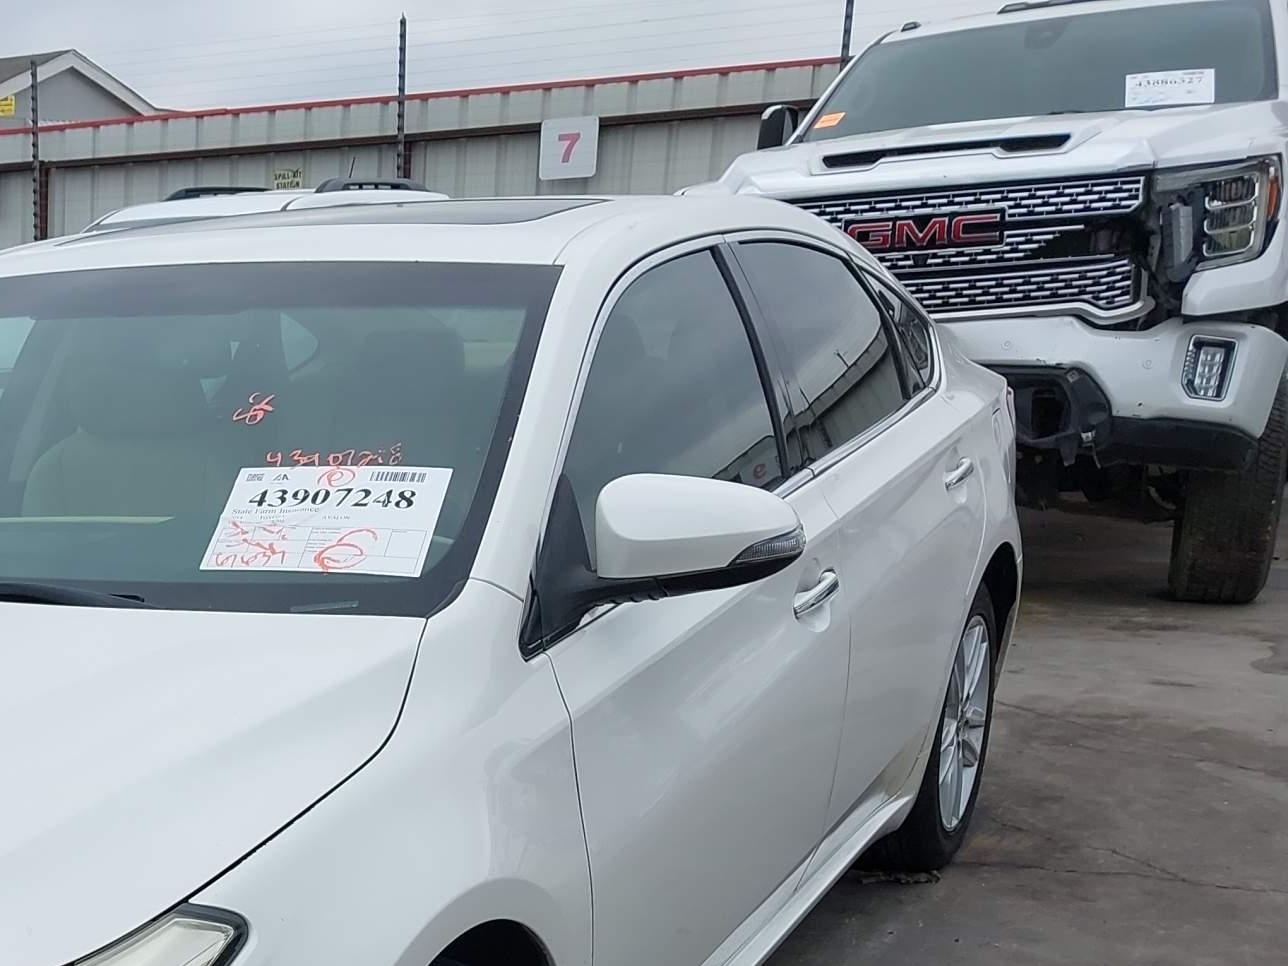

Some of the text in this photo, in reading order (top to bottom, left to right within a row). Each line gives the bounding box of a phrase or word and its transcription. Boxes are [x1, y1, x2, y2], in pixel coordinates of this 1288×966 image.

[558, 133, 581, 163] 7
[847, 213, 1000, 249] GMC
[248, 487, 417, 509] 43907248
